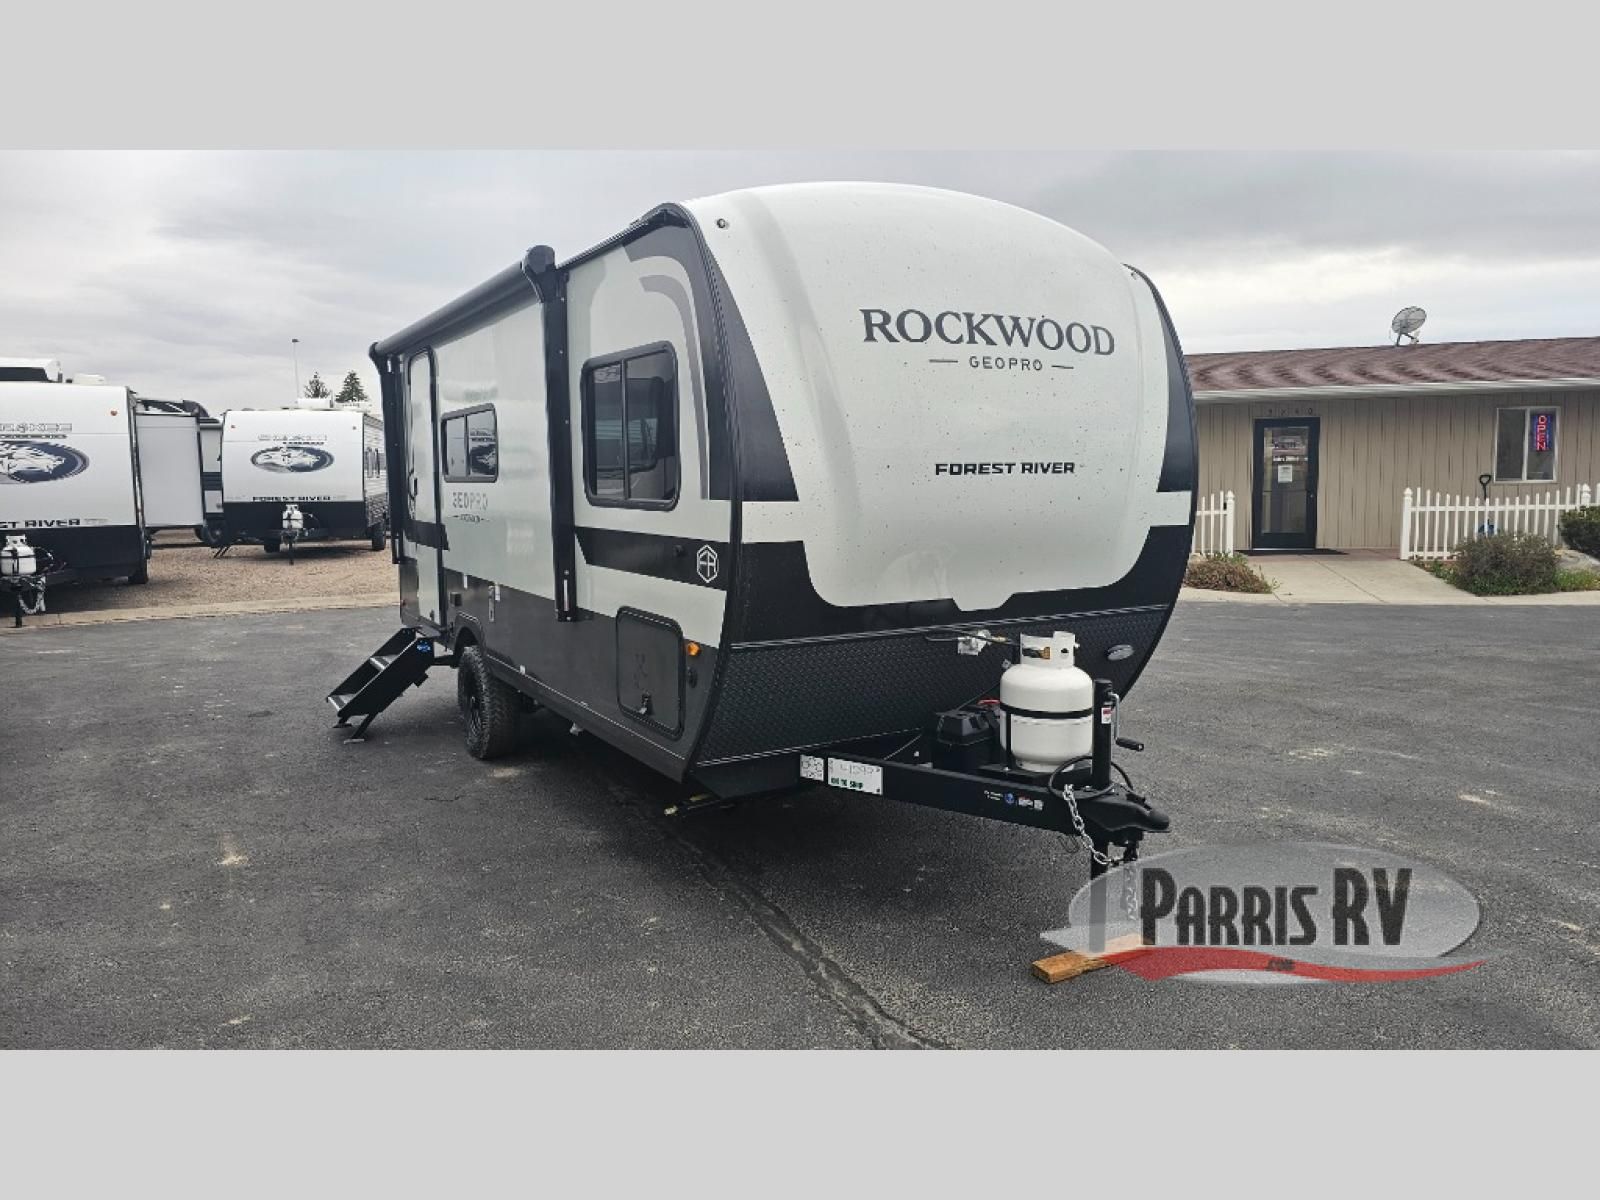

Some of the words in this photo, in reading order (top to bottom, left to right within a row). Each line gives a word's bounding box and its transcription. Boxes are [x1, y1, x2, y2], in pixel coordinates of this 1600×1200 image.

[859, 308, 1115, 356] ROCKWOOD
[969, 356, 1043, 371] GEOPRO
[1536, 415, 1548, 451] OPEN
[935, 463, 1016, 476] FOREST
[1020, 462, 1075, 475] RIVER
[24, 518, 81, 528] RIVER
